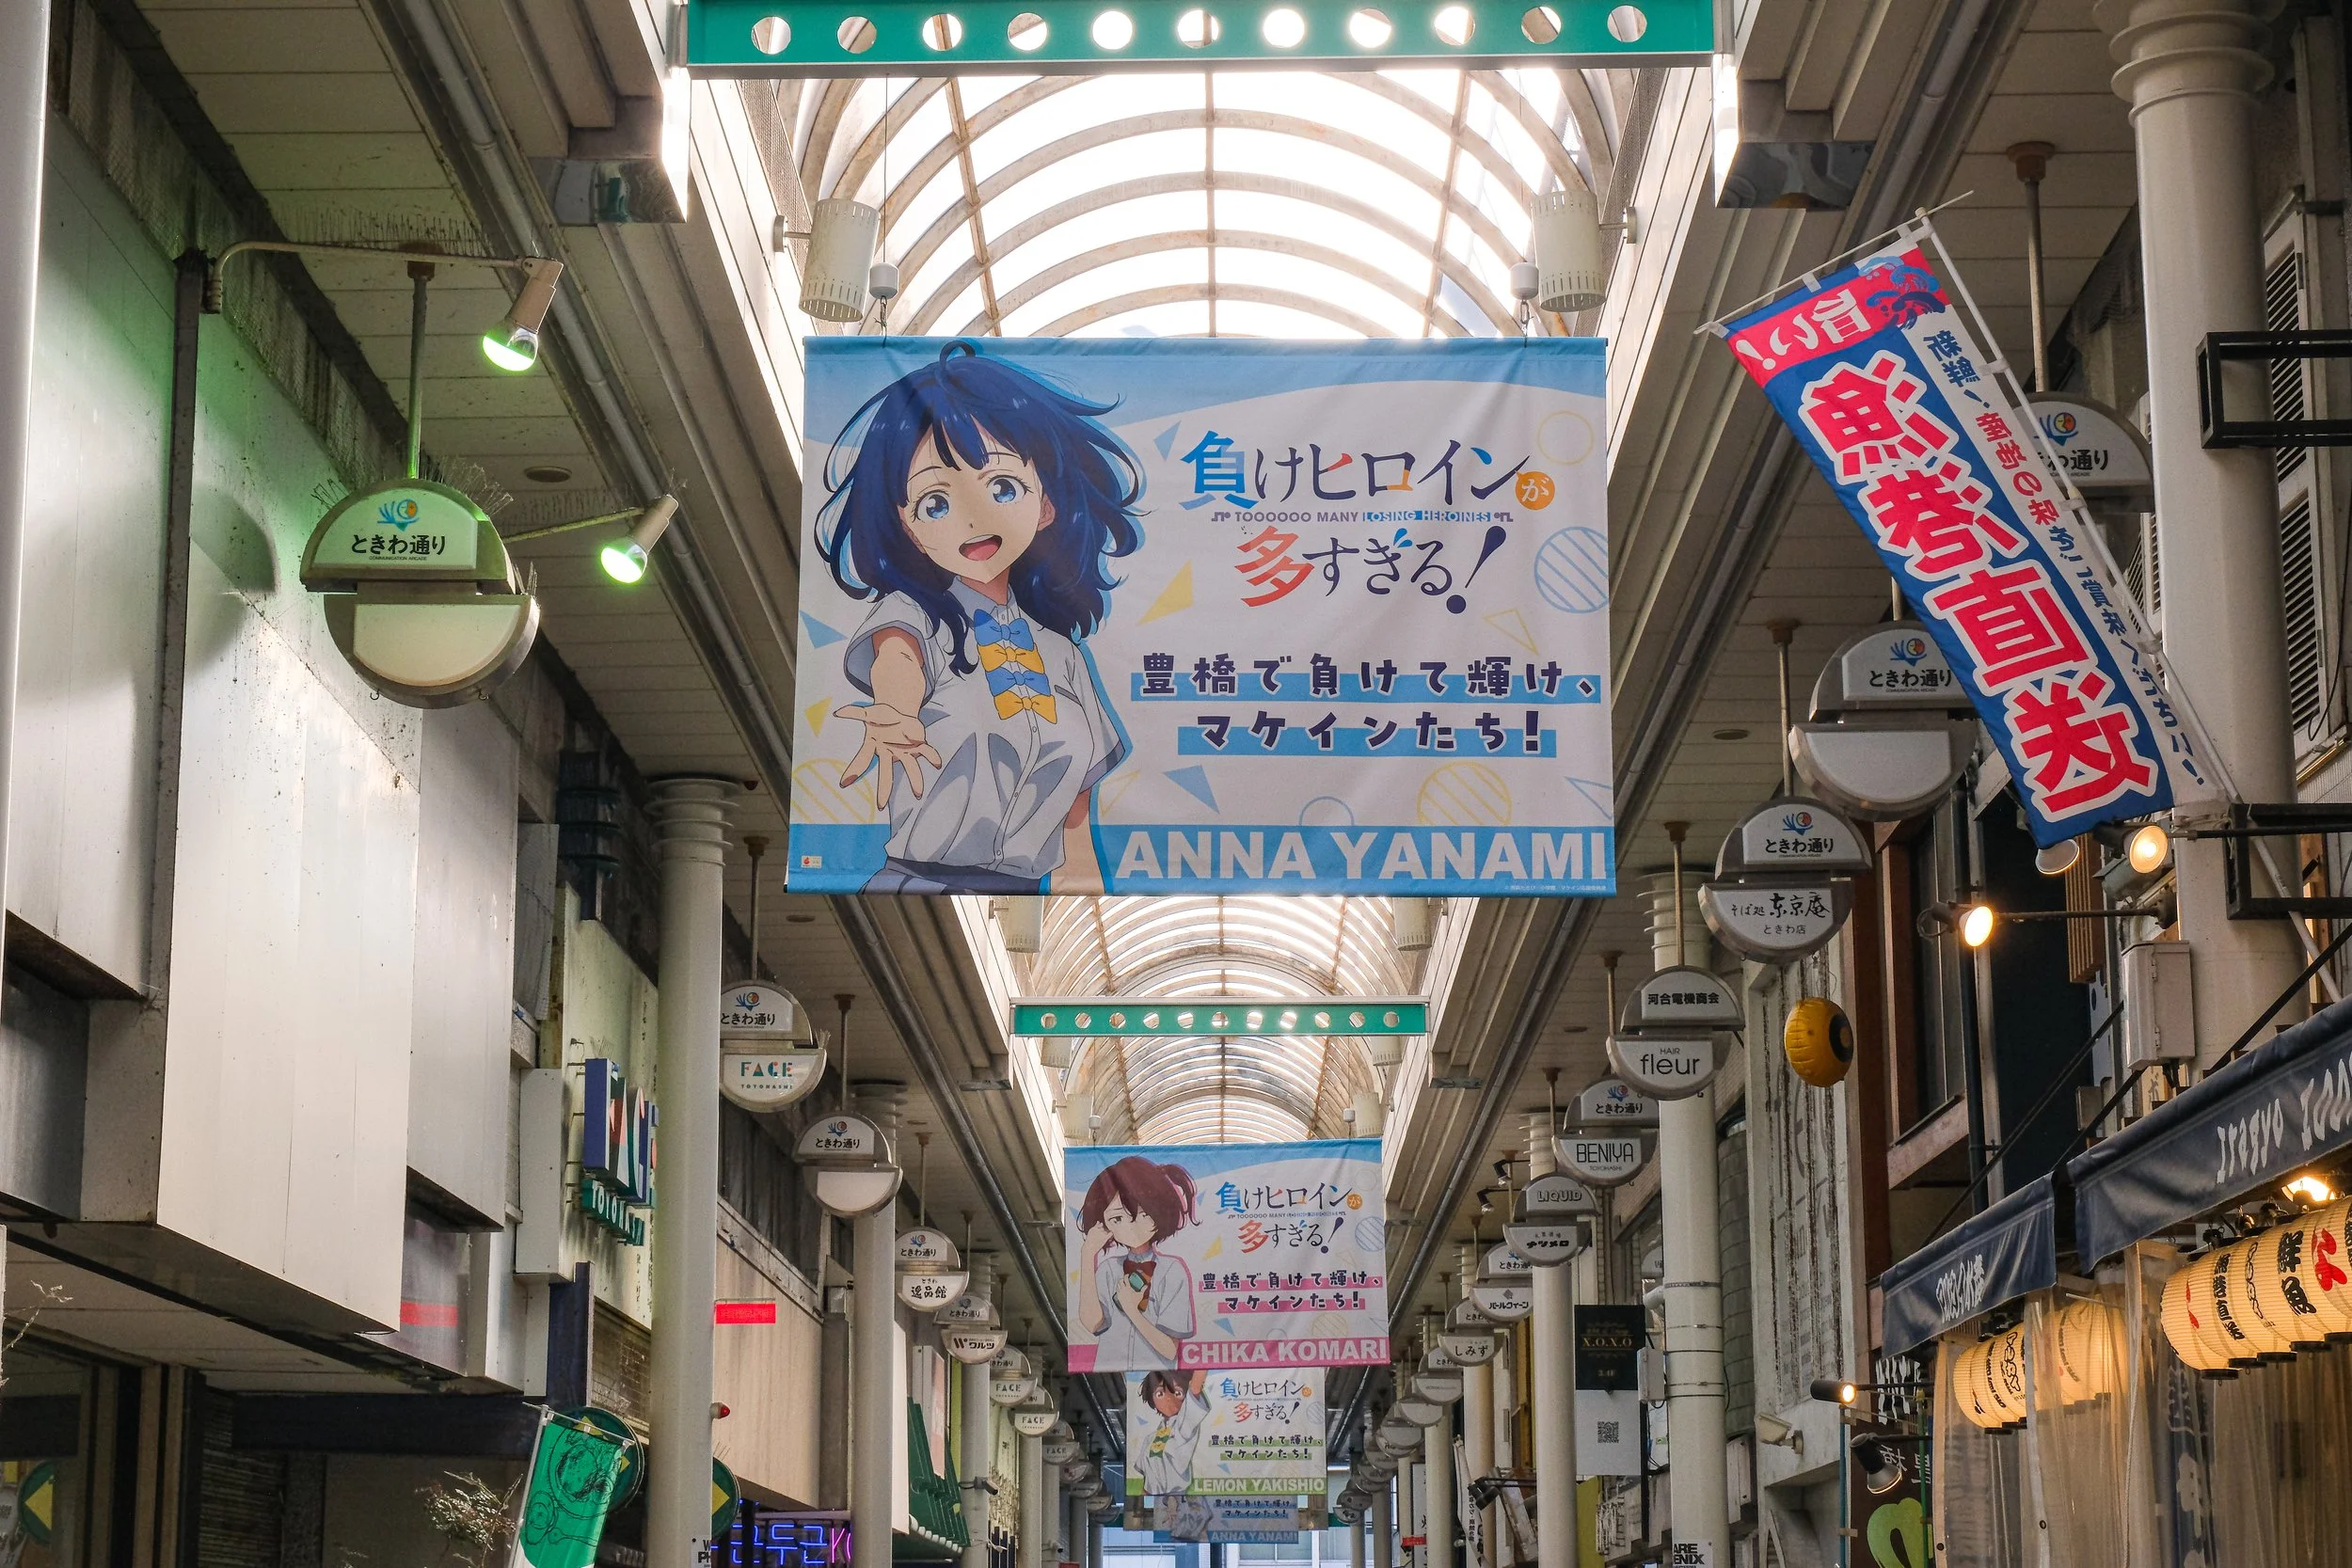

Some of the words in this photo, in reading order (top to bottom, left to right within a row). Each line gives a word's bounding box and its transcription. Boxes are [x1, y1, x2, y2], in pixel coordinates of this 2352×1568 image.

[2038, 450, 2108, 470] わ通り
[1179, 430, 1555, 511] 負けヒロインが
[1235, 512, 1311, 522] TOOOOOO
[1317, 512, 1359, 522] MANY
[1363, 511, 1417, 522] LOSING
[1422, 511, 1491, 522] HEROINES
[352, 534, 445, 555] ときわ通り
[1234, 525, 1507, 614] 多すぎる！
[1141, 652, 1596, 698] 豊橋で負けて輝け、
[1869, 669, 1951, 688] ときわ通り
[1196, 711, 1540, 753] マケインたち！
[1765, 838, 1834, 853] ときわ通り
[1115, 831, 1315, 882] ANNA
[1329, 831, 1606, 881] YANAMI
[1764, 925, 1806, 934] ときわ店
[1647, 992, 1720, 1006] 河合電機商会
[721, 1012, 775, 1026] ときわ通り
[740, 1061, 793, 1078] FACE
[1640, 1053, 1700, 1075] fleur
[1595, 1103, 1643, 1114] ときわ通り
[815, 1138, 860, 1148] ときわ通り
[1576, 1143, 1634, 1164] BENIYA
[1215, 1181, 1363, 1214] 負けヒロインが
[1537, 1191, 1581, 1202] LIQUID
[1238, 1217, 1344, 1254] 多すぎる！
[1499, 1261, 1533, 1270] ときわ通
[1202, 1270, 1381, 1291] 豊橋で負けて輝け、
[1225, 1291, 1360, 1311] マケインたち！
[1182, 1341, 1270, 1364] CHIKA
[1278, 1338, 1387, 1362] KOMARI
[1454, 1345, 1488, 1356] しみず
[1233, 1402, 1300, 1424] 多すぎる！
[1225, 1448, 1309, 1459] マケインたち！
[1194, 1479, 1248, 1493] LEMON
[1251, 1478, 1325, 1492] YAKISHIO
[1211, 1532, 1247, 1542] ANNA
